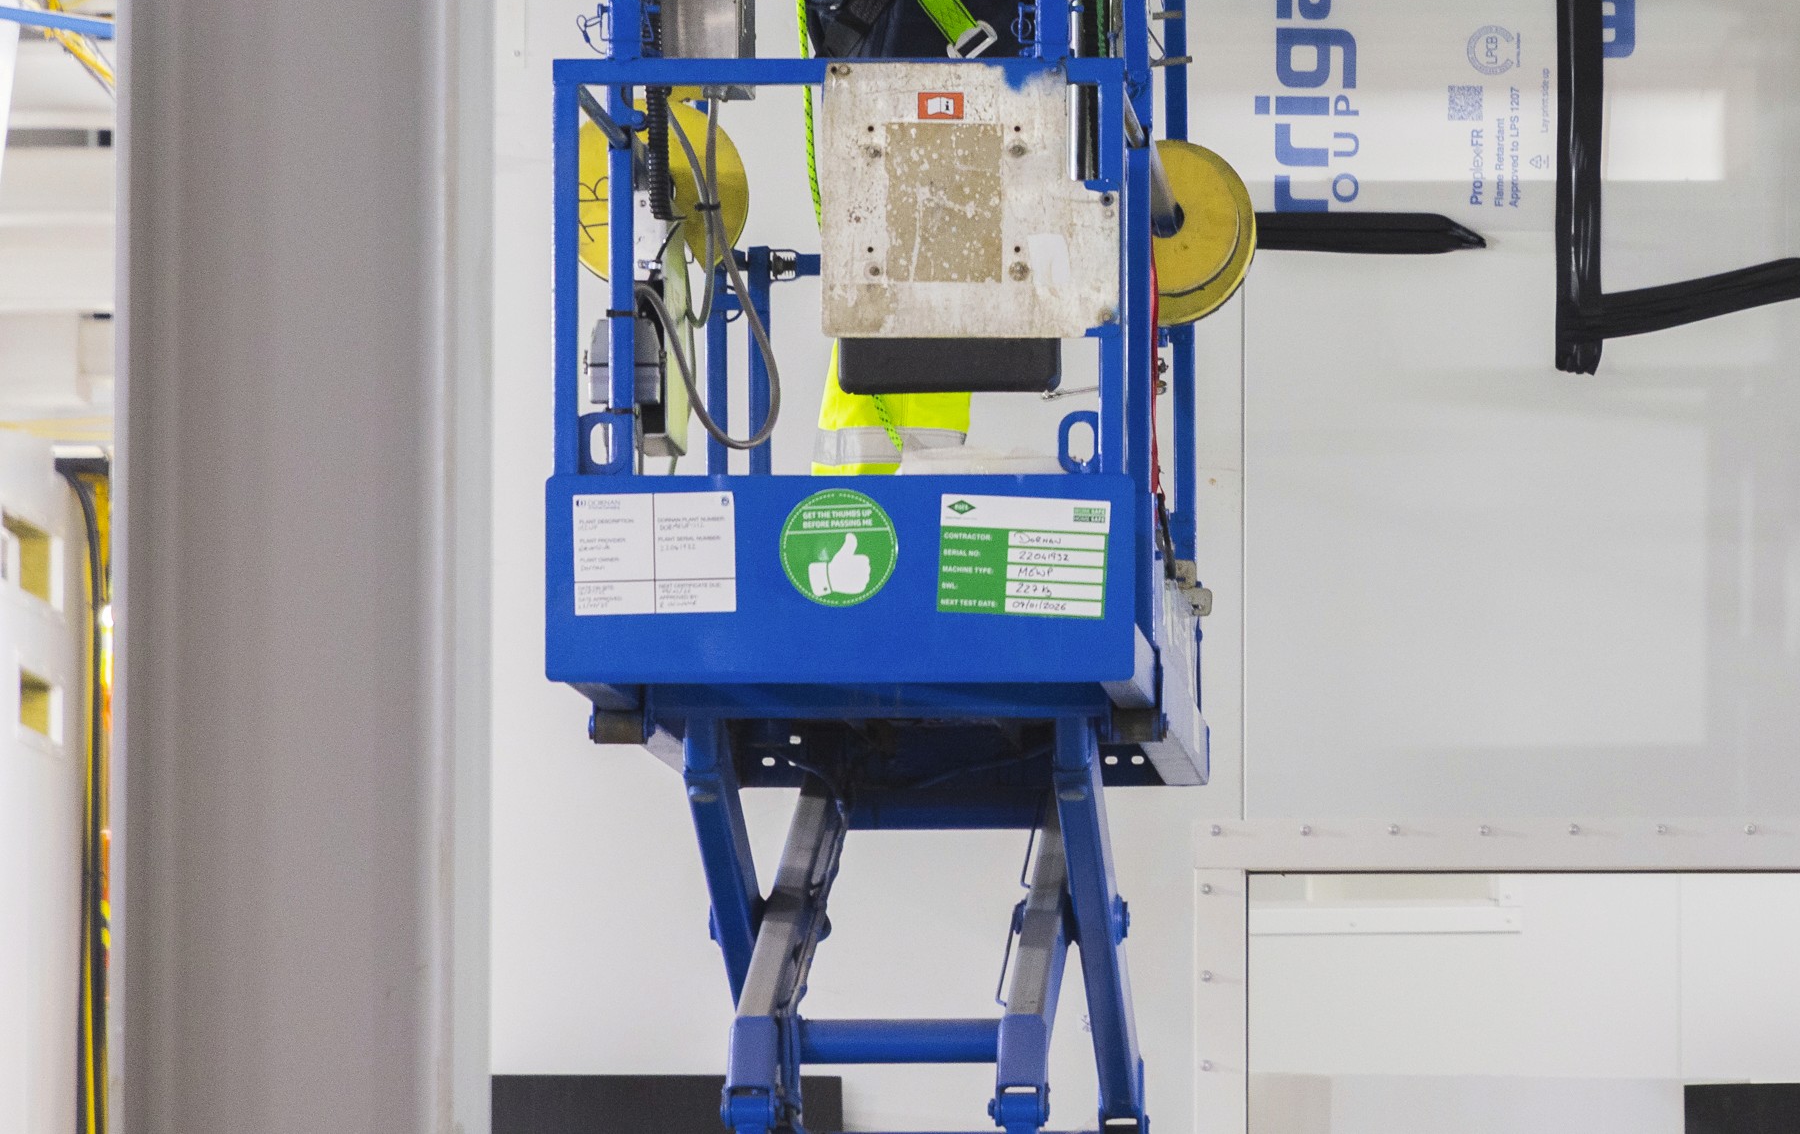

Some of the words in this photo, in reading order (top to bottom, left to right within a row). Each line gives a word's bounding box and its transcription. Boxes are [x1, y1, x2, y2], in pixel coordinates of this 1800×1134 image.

[1510, 86, 1519, 111] 1207
[1510, 116, 1519, 138] LPS
[1332, 94, 1360, 204] OUP
[1495, 118, 1504, 170] Retardant
[1510, 140, 1519, 152] to
[1495, 172, 1504, 207] Flame
[1509, 153, 1520, 208] Approved
[803, 511, 816, 519] GET
[818, 511, 830, 519] THE
[832, 510, 861, 518] THUMBS
[803, 520, 829, 528] BEFORE
[831, 519, 861, 527] PASSING
[863, 518, 873, 526] ME
[1016, 583, 1038, 593] 227
[941, 598, 957, 606] NEXT
[960, 599, 977, 607] TEST
